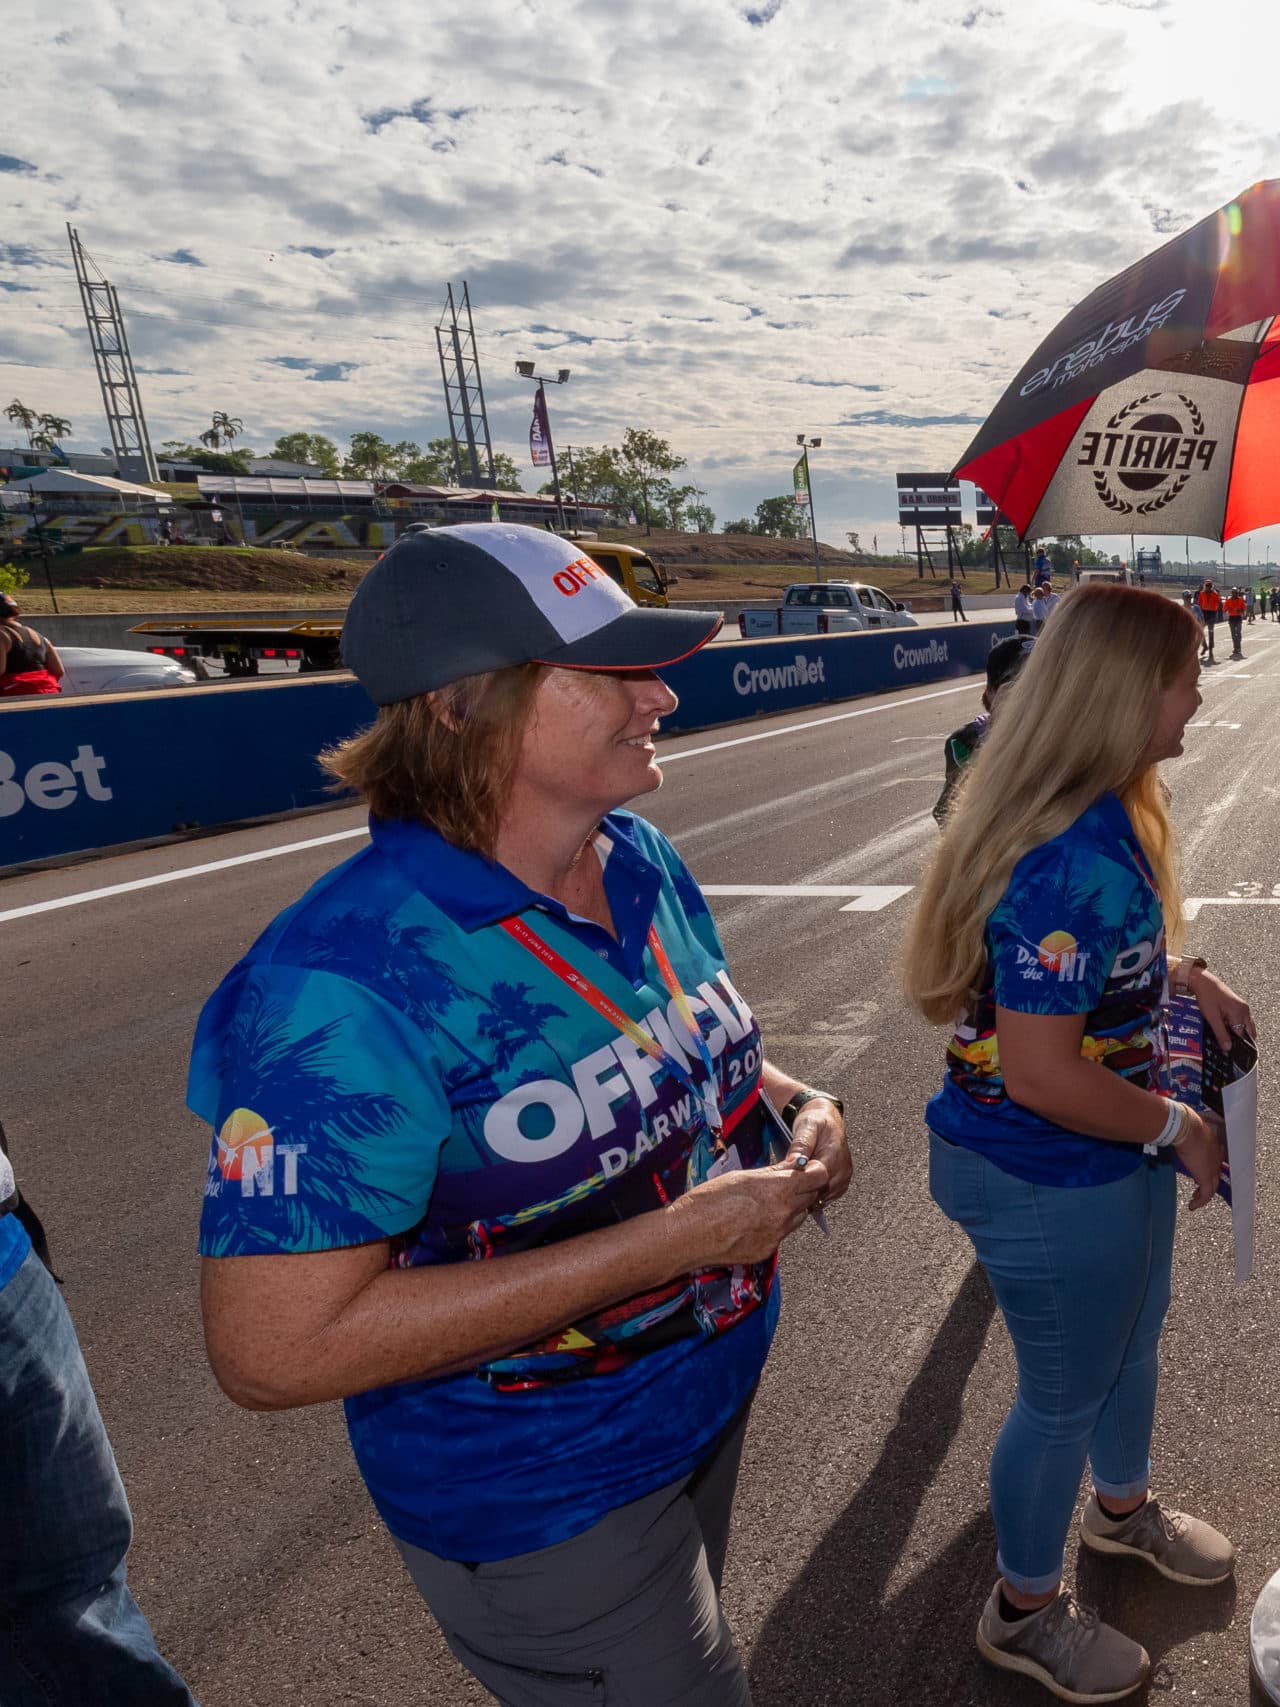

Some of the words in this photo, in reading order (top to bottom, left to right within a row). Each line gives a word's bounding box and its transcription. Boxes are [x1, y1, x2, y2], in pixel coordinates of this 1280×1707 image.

[1020, 288, 1187, 396] erebus
[1052, 314, 1171, 389] motorsport
[894, 639, 948, 670] CrownBet
[733, 655, 825, 695] CrownBet
[1016, 944, 1039, 967] Do
[1020, 967, 1044, 981] the
[1058, 952, 1091, 982] NT
[729, 1041, 763, 1087] 201
[241, 1143, 308, 1197] NT
